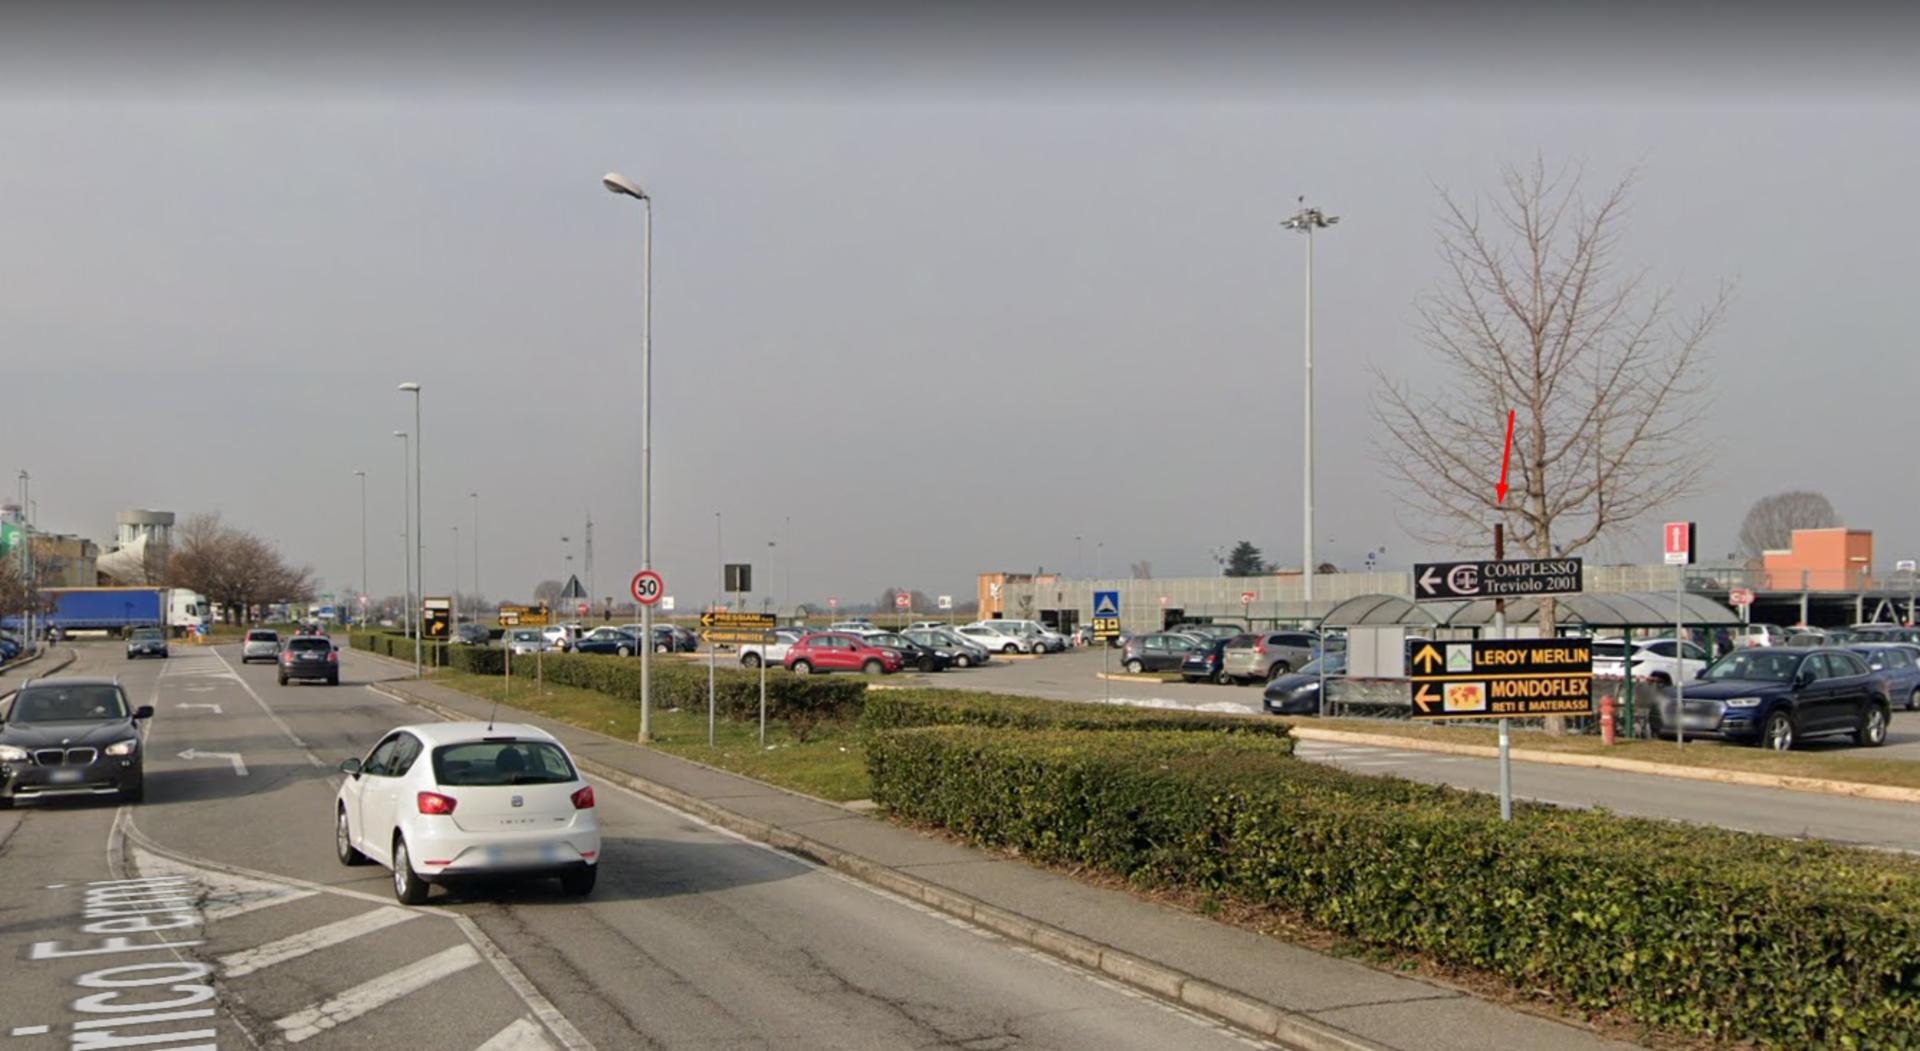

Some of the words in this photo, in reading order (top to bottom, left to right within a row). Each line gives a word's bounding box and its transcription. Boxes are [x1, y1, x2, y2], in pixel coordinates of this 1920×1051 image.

[1484, 561, 1578, 577] COMPLESSO
[638, 579, 657, 596] 50
[1484, 579, 1543, 593] Treviolo
[1546, 577, 1576, 590] 2001
[1475, 650, 1528, 665] LEROY
[1531, 648, 1589, 663] MERLIN
[1491, 679, 1588, 697] MONDOFLEX
[1492, 702, 1515, 712] RETI
[1519, 702, 1526, 711] E
[1528, 700, 1588, 710] MATERASSI
